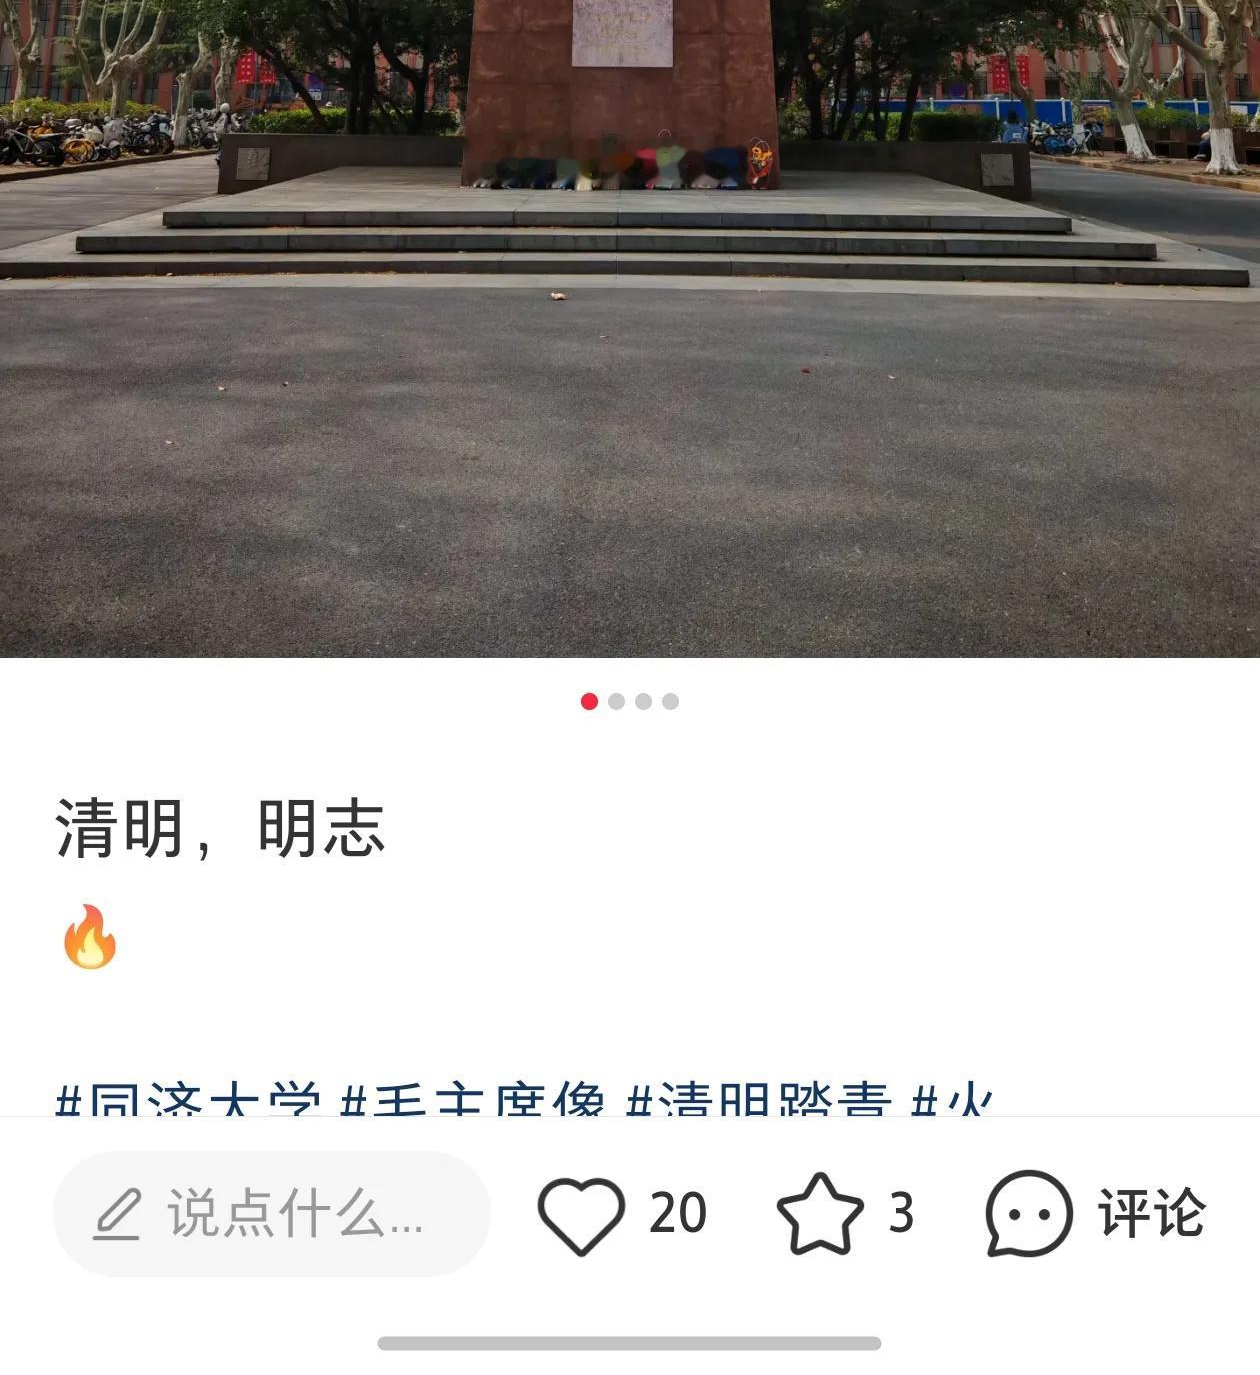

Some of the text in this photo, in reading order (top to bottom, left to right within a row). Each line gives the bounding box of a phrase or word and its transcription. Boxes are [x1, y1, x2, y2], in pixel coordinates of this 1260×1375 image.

[55, 796, 385, 862] 清明，明志
[649, 1191, 707, 1234] 20
[889, 1191, 914, 1234] 3
[1097, 1186, 1208, 1239] 评论
